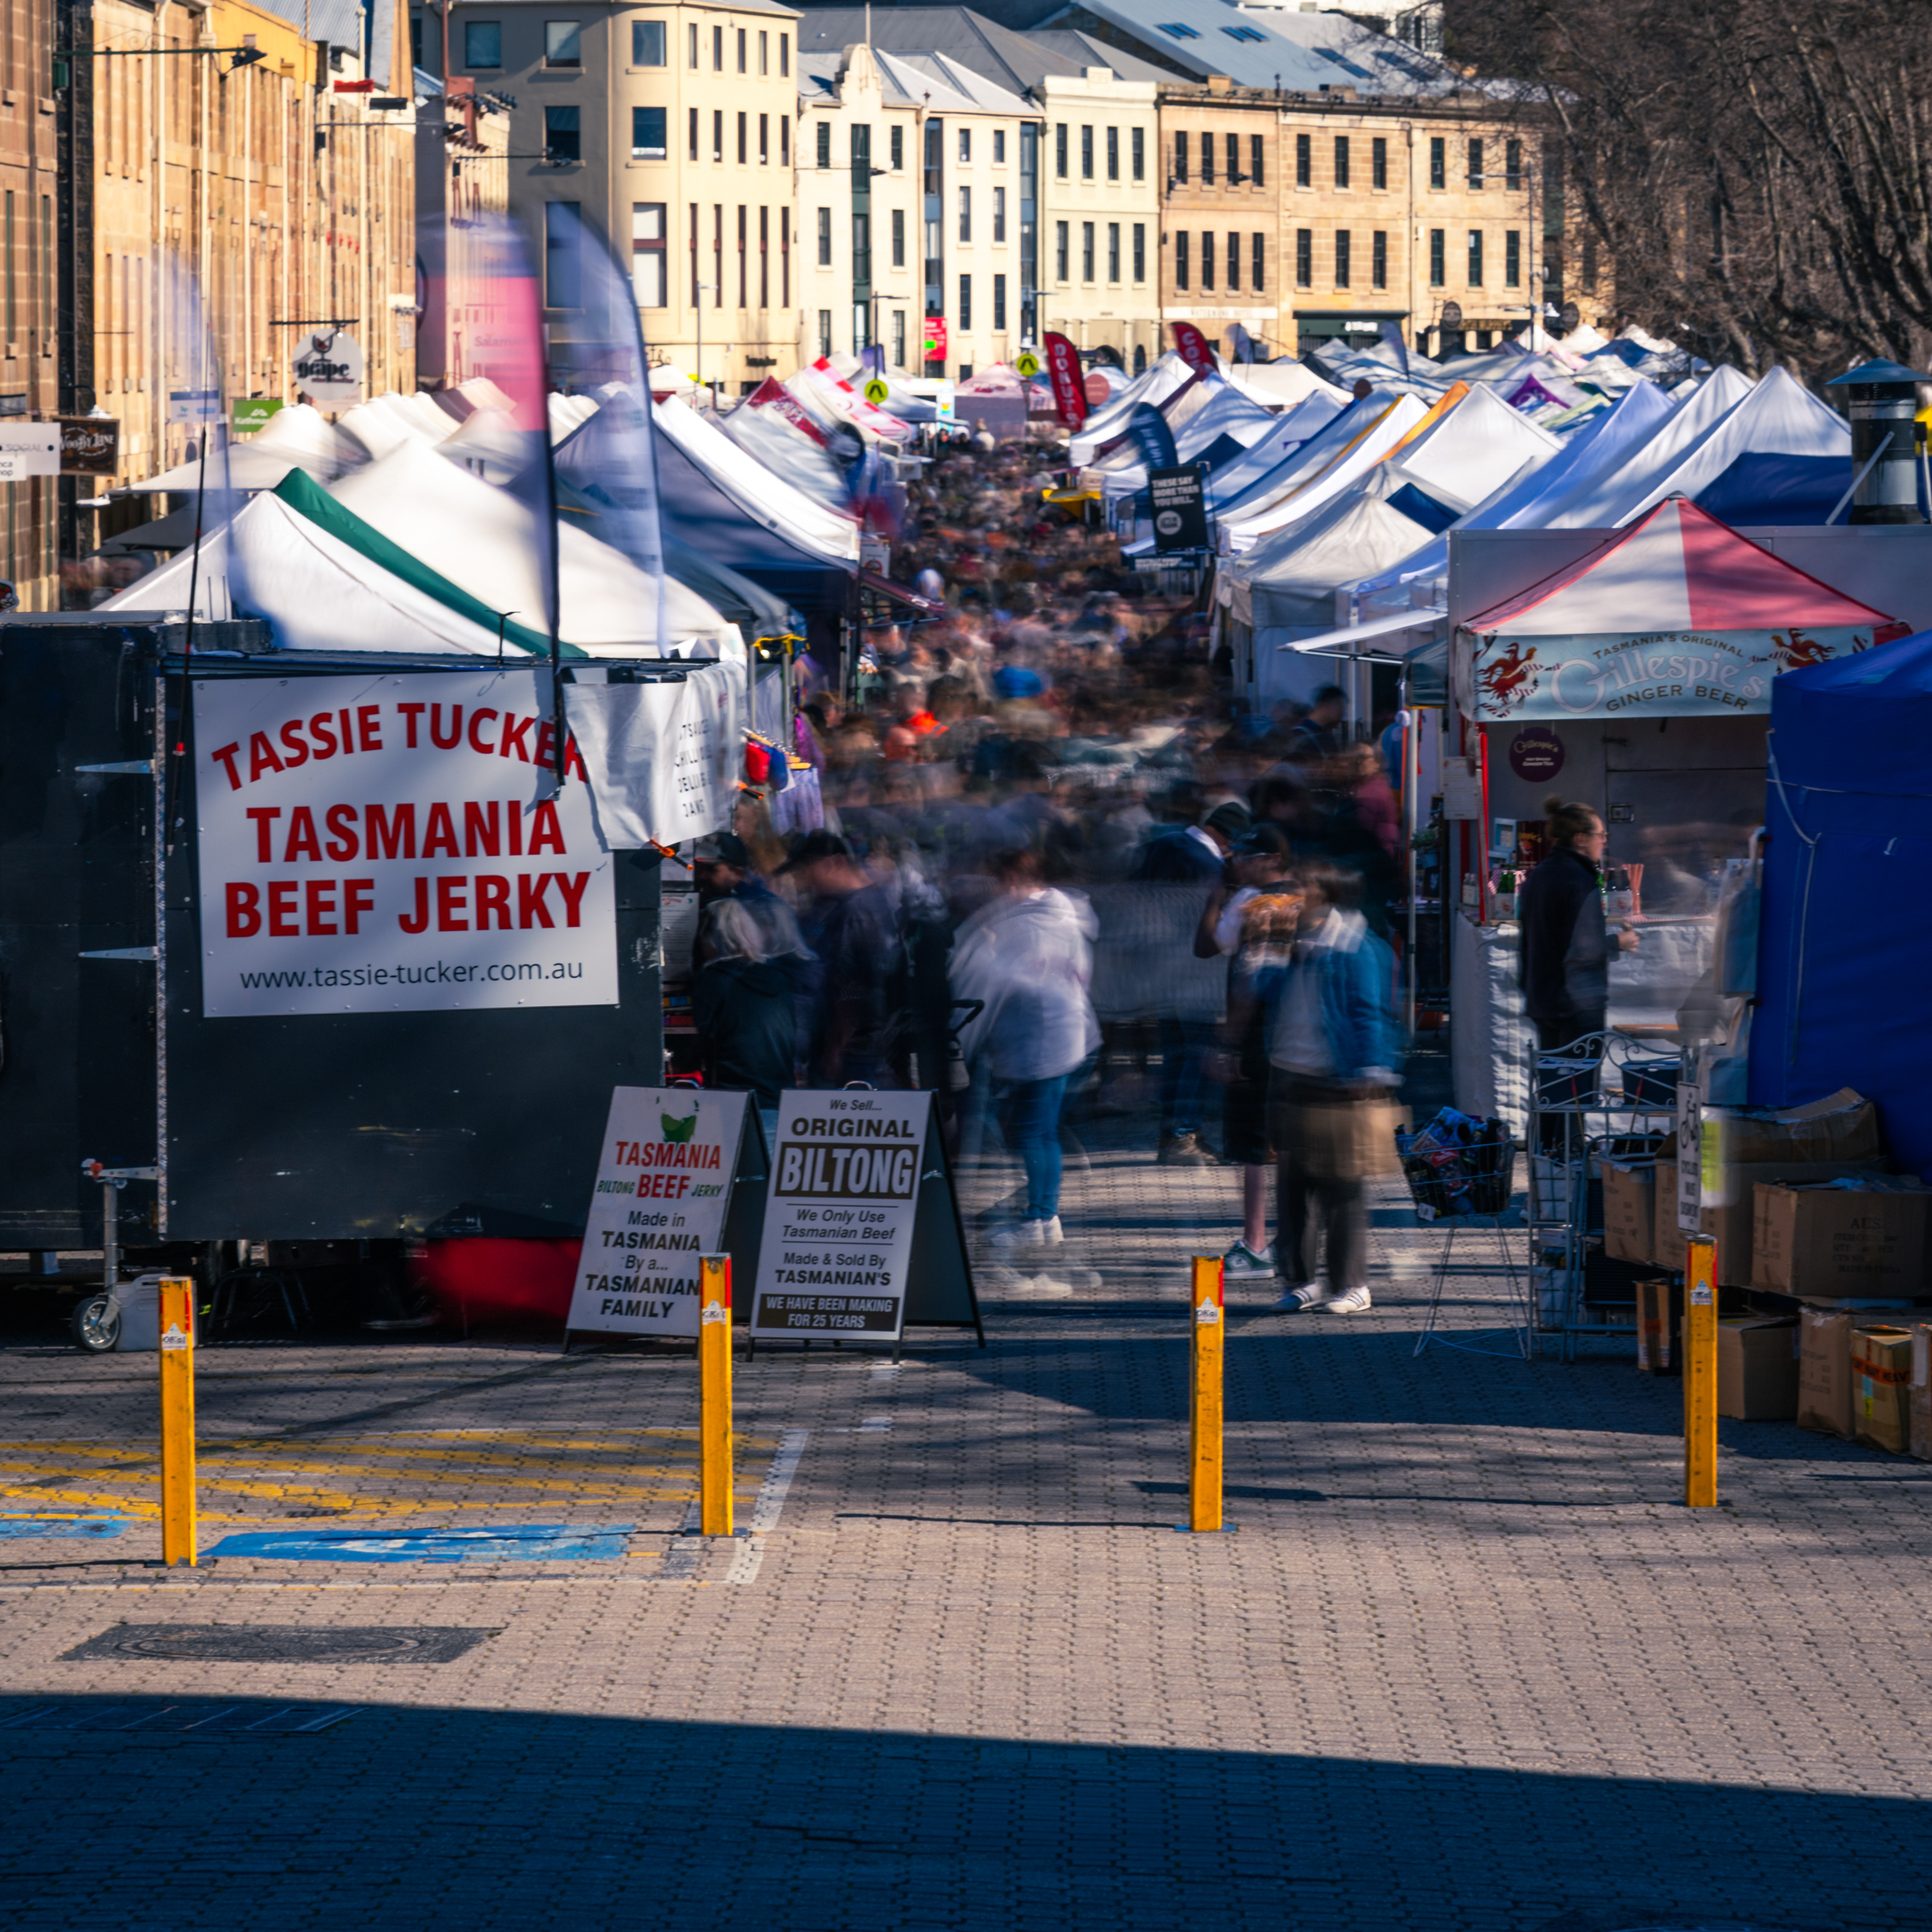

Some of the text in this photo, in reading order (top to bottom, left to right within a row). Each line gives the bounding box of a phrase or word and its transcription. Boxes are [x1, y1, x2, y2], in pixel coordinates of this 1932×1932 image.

[297, 362, 350, 382] grape
[1054, 343, 1080, 425] DONUTS
[1151, 478, 1177, 489] THESE
[1153, 485, 1200, 498] MORE THAN
[1592, 633, 1744, 660] TASMANIA'S ORIGINAL
[1550, 648, 1766, 714] Gillespie's
[1605, 684, 1748, 712] GINGER BEER
[212, 703, 590, 791] TASSIE TUCKER
[246, 799, 567, 863] TASMANIA
[225, 875, 374, 938] BEEF
[398, 872, 590, 934] JERKY
[239, 959, 582, 989] www.tassie-tucker.com.au
[830, 1099, 847, 1110] We
[791, 1117, 915, 1138] ORIGINAL
[615, 1141, 720, 1169] TASMANIA
[780, 1147, 914, 1194] BILTONG
[596, 1174, 725, 1199] BILTONG BEEF JERKY
[627, 1211, 686, 1228] Made in
[796, 1209, 886, 1225] We Only Use
[602, 1231, 701, 1251] TASMANIA
[782, 1225, 896, 1240] Tasmanian Beef
[625, 1255, 646, 1273] By
[783, 1252, 887, 1269] Made & Sold By
[585, 1274, 700, 1296] TASMANIAN
[775, 1269, 891, 1285] TASMANIAN'S
[600, 1299, 675, 1318] FAMILY
[766, 1297, 894, 1312] WE HAVE BEEN MAKING
[787, 1313, 866, 1328] FOR 25 YEARS
